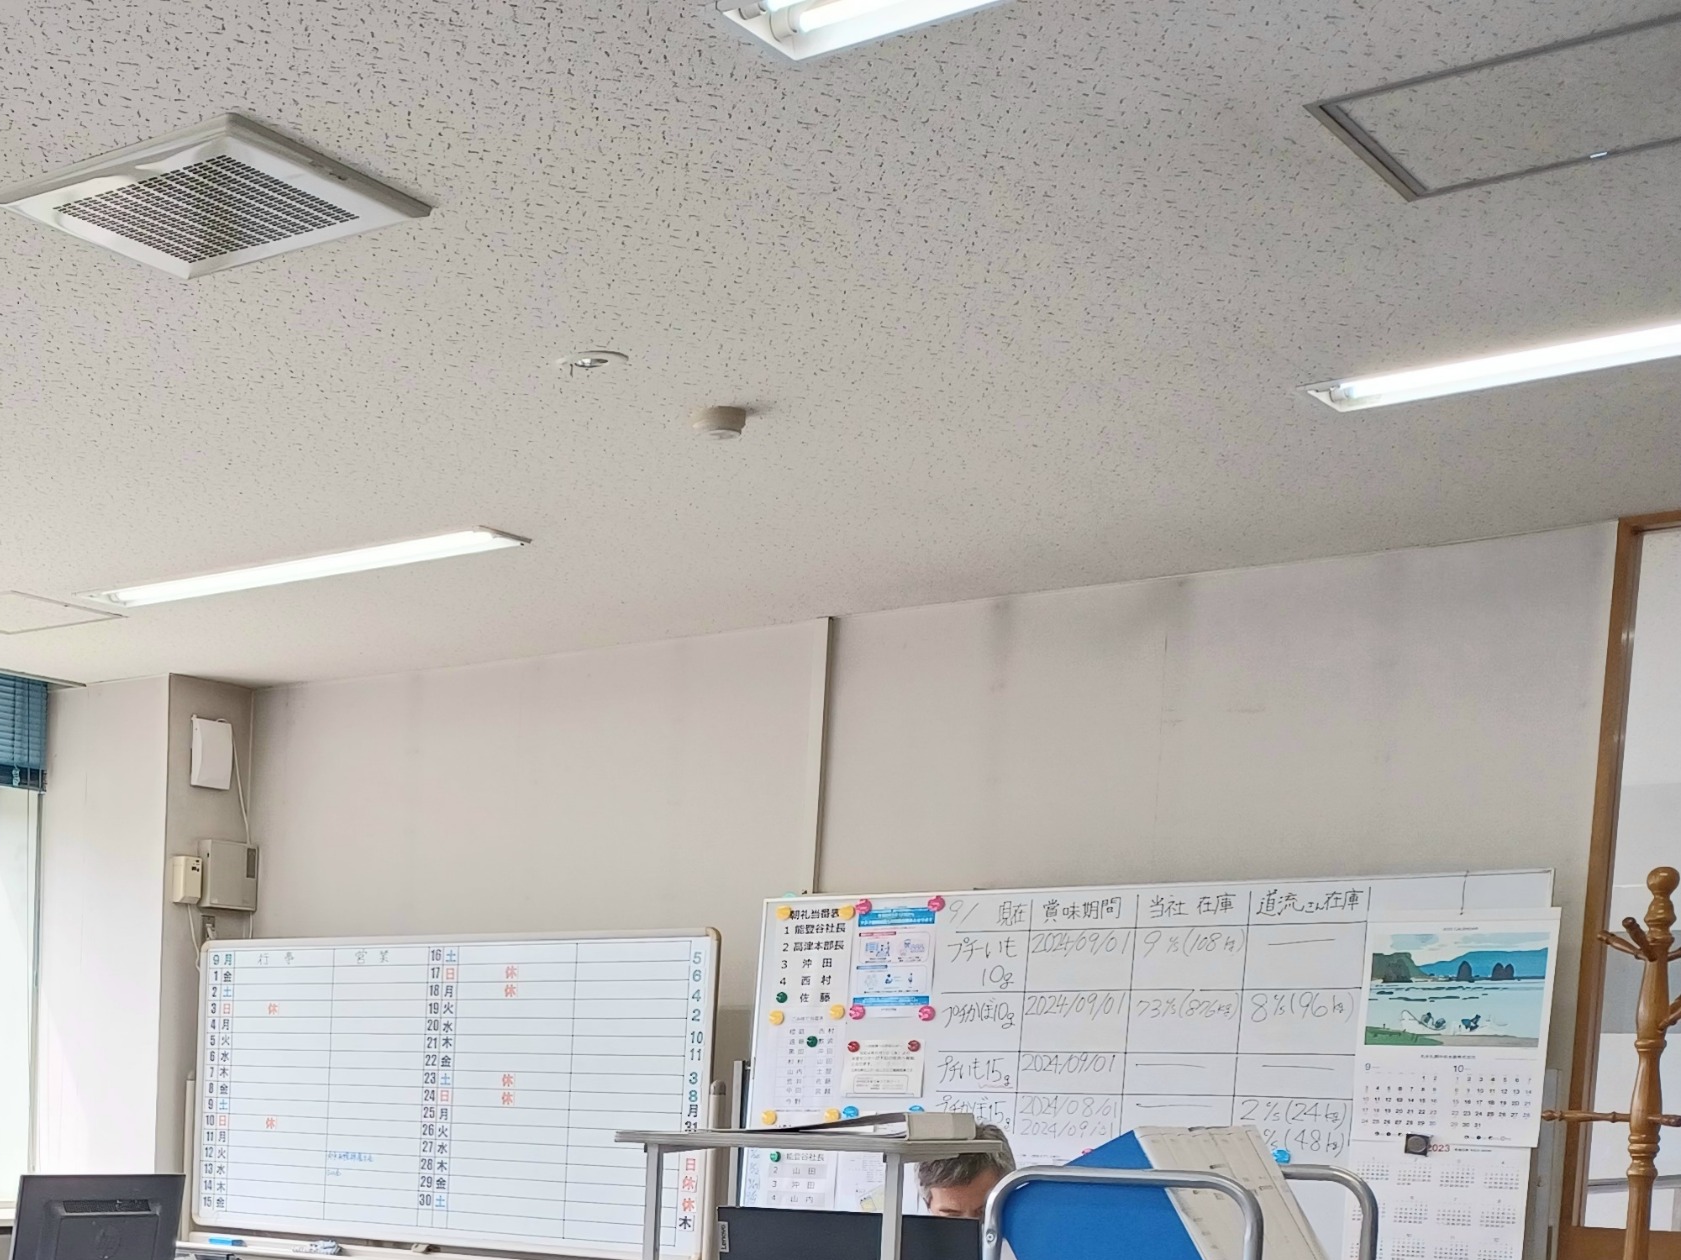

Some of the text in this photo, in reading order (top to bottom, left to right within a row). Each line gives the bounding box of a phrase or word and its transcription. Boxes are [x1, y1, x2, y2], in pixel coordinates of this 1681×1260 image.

[1150, 892, 1236, 918] 当社 在庫
[784, 926, 789, 934] 1
[782, 943, 788, 952] 2
[1031, 930, 1132, 958] 2024/09/01
[213, 954, 220, 966] 9
[224, 954, 232, 966] 月
[431, 950, 456, 962] 16 土
[693, 952, 702, 964] 5
[781, 960, 788, 969] 3
[214, 970, 232, 982] 1 金
[431, 966, 517, 980] 17 日 休
[692, 970, 702, 982] 6
[780, 977, 786, 986] 4
[212, 986, 232, 998] 2 土
[430, 984, 516, 998] 18 月 休
[692, 989, 702, 1002] 4
[210, 1003, 278, 1015] 3 日 休
[428, 1002, 454, 1014] 19 火
[1024, 992, 1126, 1020] 2024/09/01
[692, 1009, 700, 1022] 2
[210, 1019, 230, 1030] 4 月
[427, 1020, 453, 1032] 20 水
[210, 1035, 230, 1046] 5 火
[426, 1036, 452, 1048] 21 木
[690, 1032, 703, 1044] 10
[210, 1051, 230, 1062] 6 水
[690, 1048, 702, 1061] 11
[425, 1055, 452, 1068] 22 金
[1022, 1052, 1116, 1074] 2024/09/01
[209, 1066, 228, 1078] 7 木
[688, 1072, 698, 1084] 3
[424, 1072, 514, 1087] 23 土 休
[208, 1083, 228, 1095] 8 金
[424, 1090, 514, 1105] 24 日 休
[688, 1090, 698, 1102] 8
[208, 1098, 228, 1110] 9 土
[423, 1107, 448, 1120] 25 月
[688, 1104, 698, 1118] 月
[206, 1115, 276, 1129] 10 日 休
[206, 1131, 226, 1142] 11 月
[422, 1124, 448, 1138] 26 火
[205, 1146, 226, 1158] 12 火
[422, 1141, 448, 1154] 27 水
[204, 1162, 226, 1174] 13 水
[420, 1158, 448, 1172] 28 木
[686, 1158, 696, 1172] 日
[204, 1180, 226, 1192] 14 木
[420, 1176, 446, 1190] 29 金
[682, 1175, 696, 1191] 休
[203, 1196, 224, 1208] 15 金
[419, 1194, 446, 1208] 30 土
[682, 1198, 694, 1212] 休
[679, 1216, 692, 1230] 木
